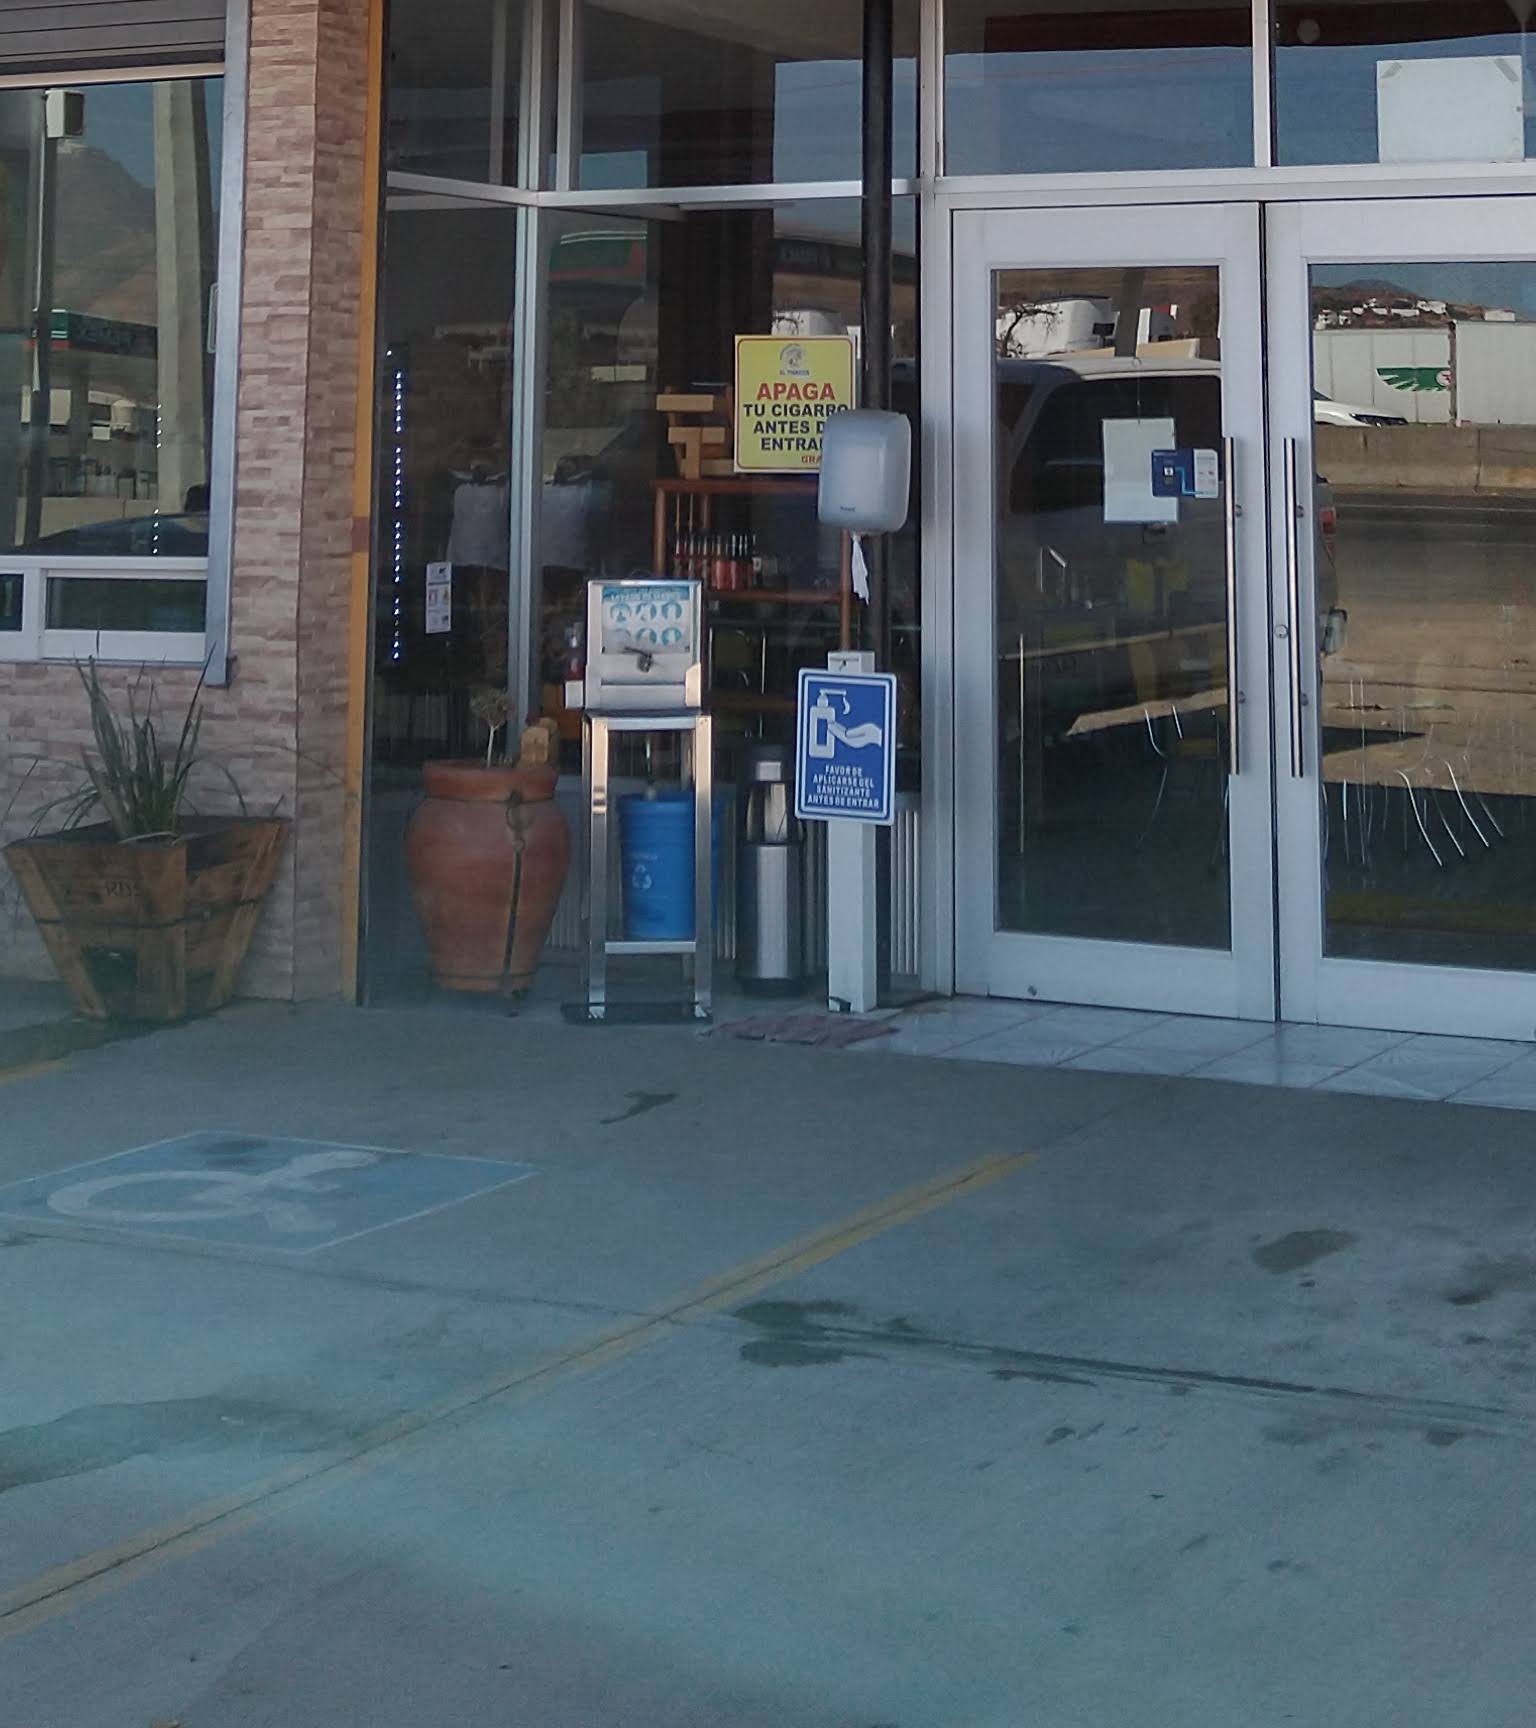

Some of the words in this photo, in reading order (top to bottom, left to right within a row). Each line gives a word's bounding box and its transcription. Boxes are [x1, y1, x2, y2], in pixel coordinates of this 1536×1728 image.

[756, 382, 836, 401] APAGA
[743, 404, 766, 418] TU
[753, 421, 810, 435] ANTES
[825, 764, 851, 775] FAVOR
[852, 766, 863, 777] DE
[812, 773, 857, 787] APLICARSE
[858, 777, 875, 789] GEL
[816, 784, 871, 798] SANITIZANTE
[807, 794, 834, 806] ANTES
[835, 796, 845, 807] DE
[846, 798, 880, 809] ENTRAR
